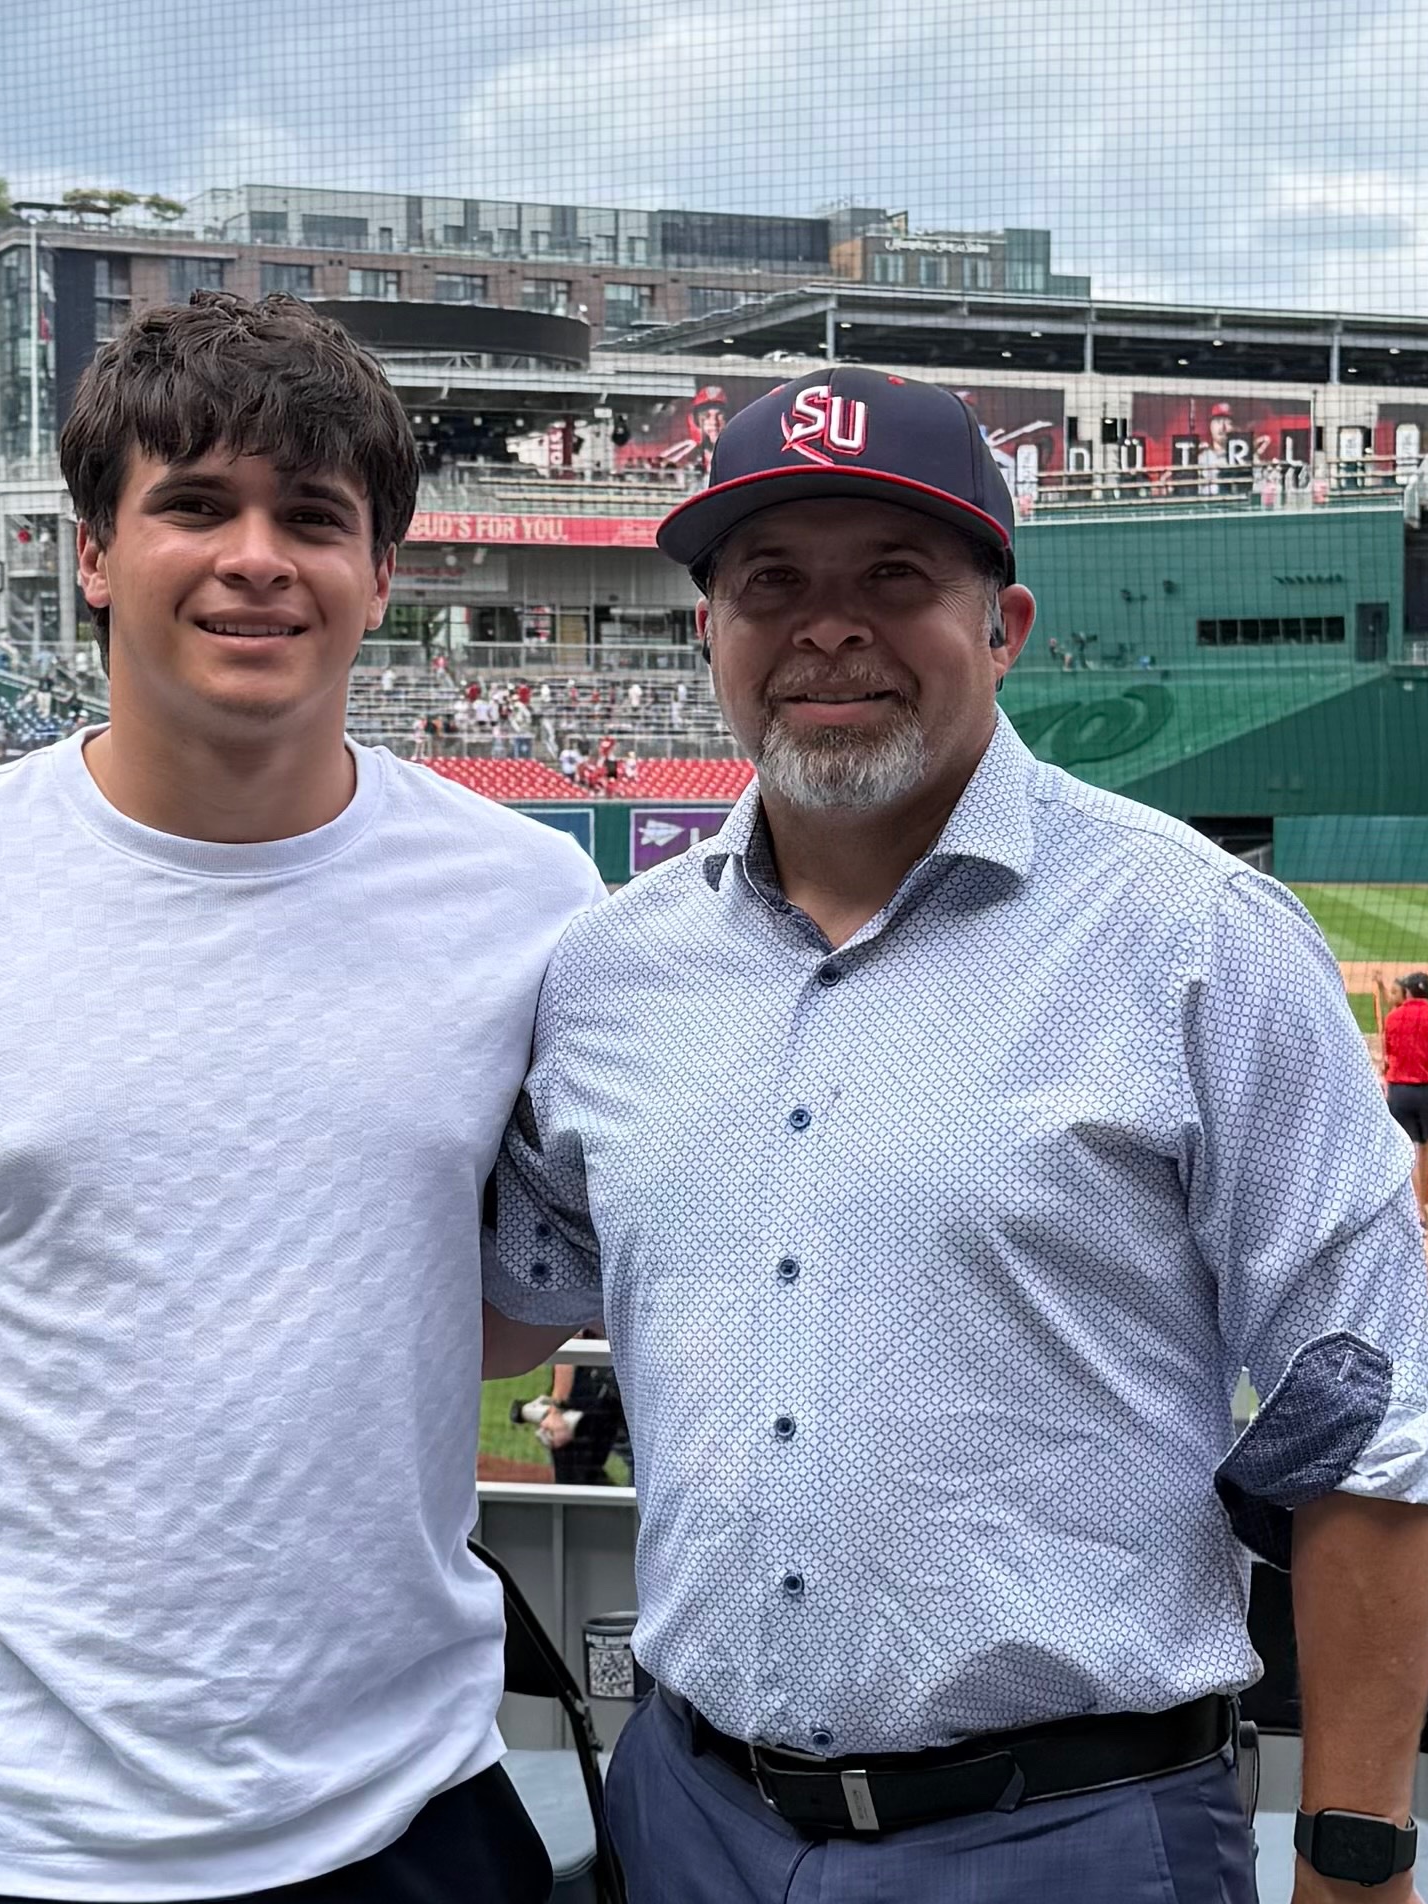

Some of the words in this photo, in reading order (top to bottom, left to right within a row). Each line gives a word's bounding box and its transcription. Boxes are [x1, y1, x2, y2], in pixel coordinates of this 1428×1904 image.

[787, 385, 867, 456] SU
[476, 517, 515, 540] FOR
[522, 518, 569, 541] YOU.
